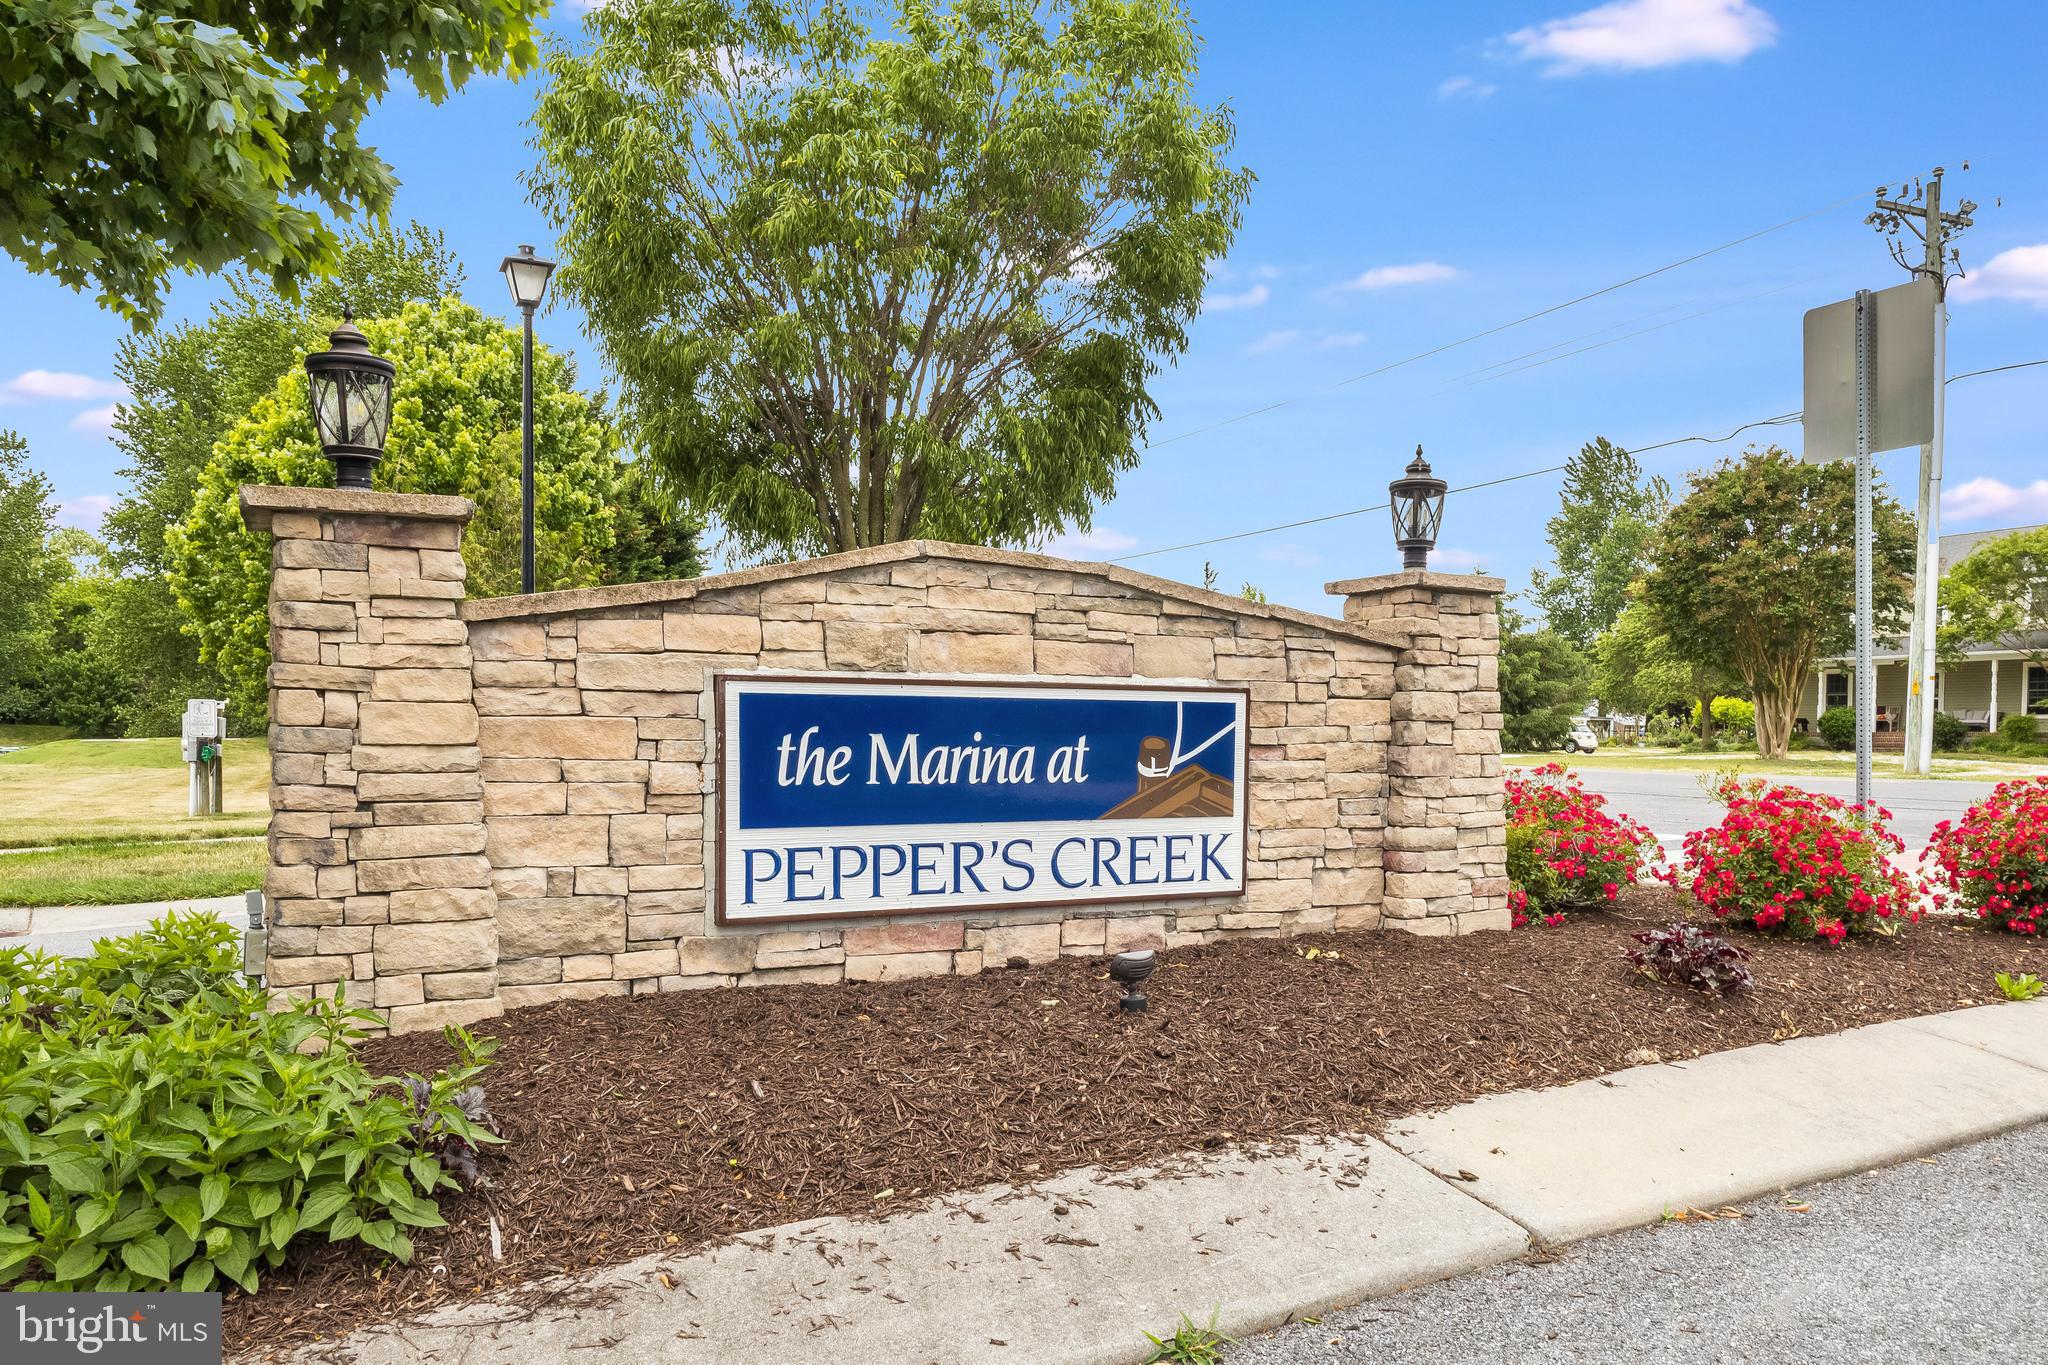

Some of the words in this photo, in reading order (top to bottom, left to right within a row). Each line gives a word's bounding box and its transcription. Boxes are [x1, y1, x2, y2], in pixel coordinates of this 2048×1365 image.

[777, 726, 850, 786] the
[867, 731, 1035, 785] Marina
[1046, 735, 1090, 784] at
[741, 840, 1036, 905] PEPPER'S
[1050, 833, 1234, 889] CREEK
